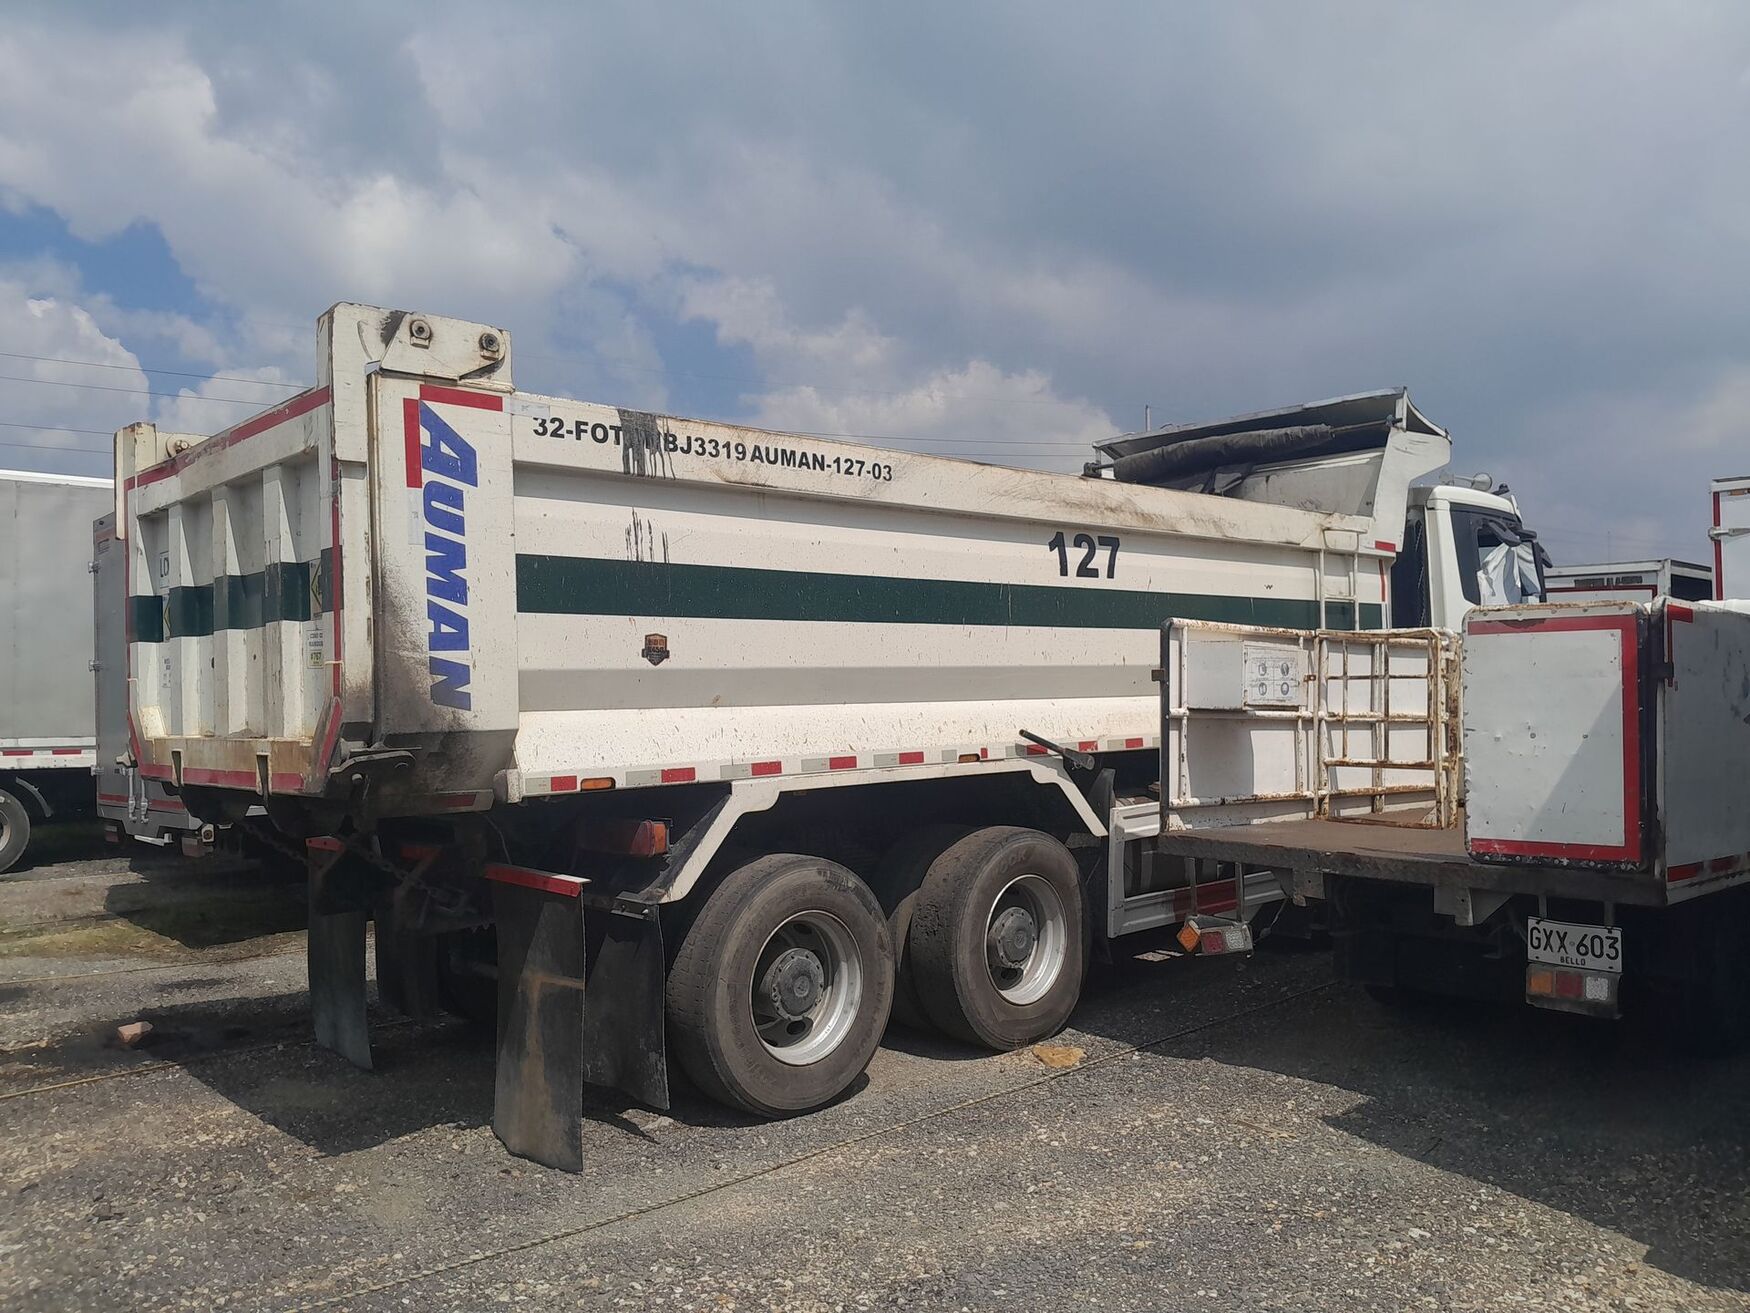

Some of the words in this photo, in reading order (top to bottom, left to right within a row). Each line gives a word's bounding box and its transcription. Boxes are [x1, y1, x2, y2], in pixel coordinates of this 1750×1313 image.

[533, 417, 661, 451] 32-FOT
[420, 400, 478, 711] AUMAN
[1048, 531, 1120, 579] 127
[1560, 956, 1586, 966] BELLO
